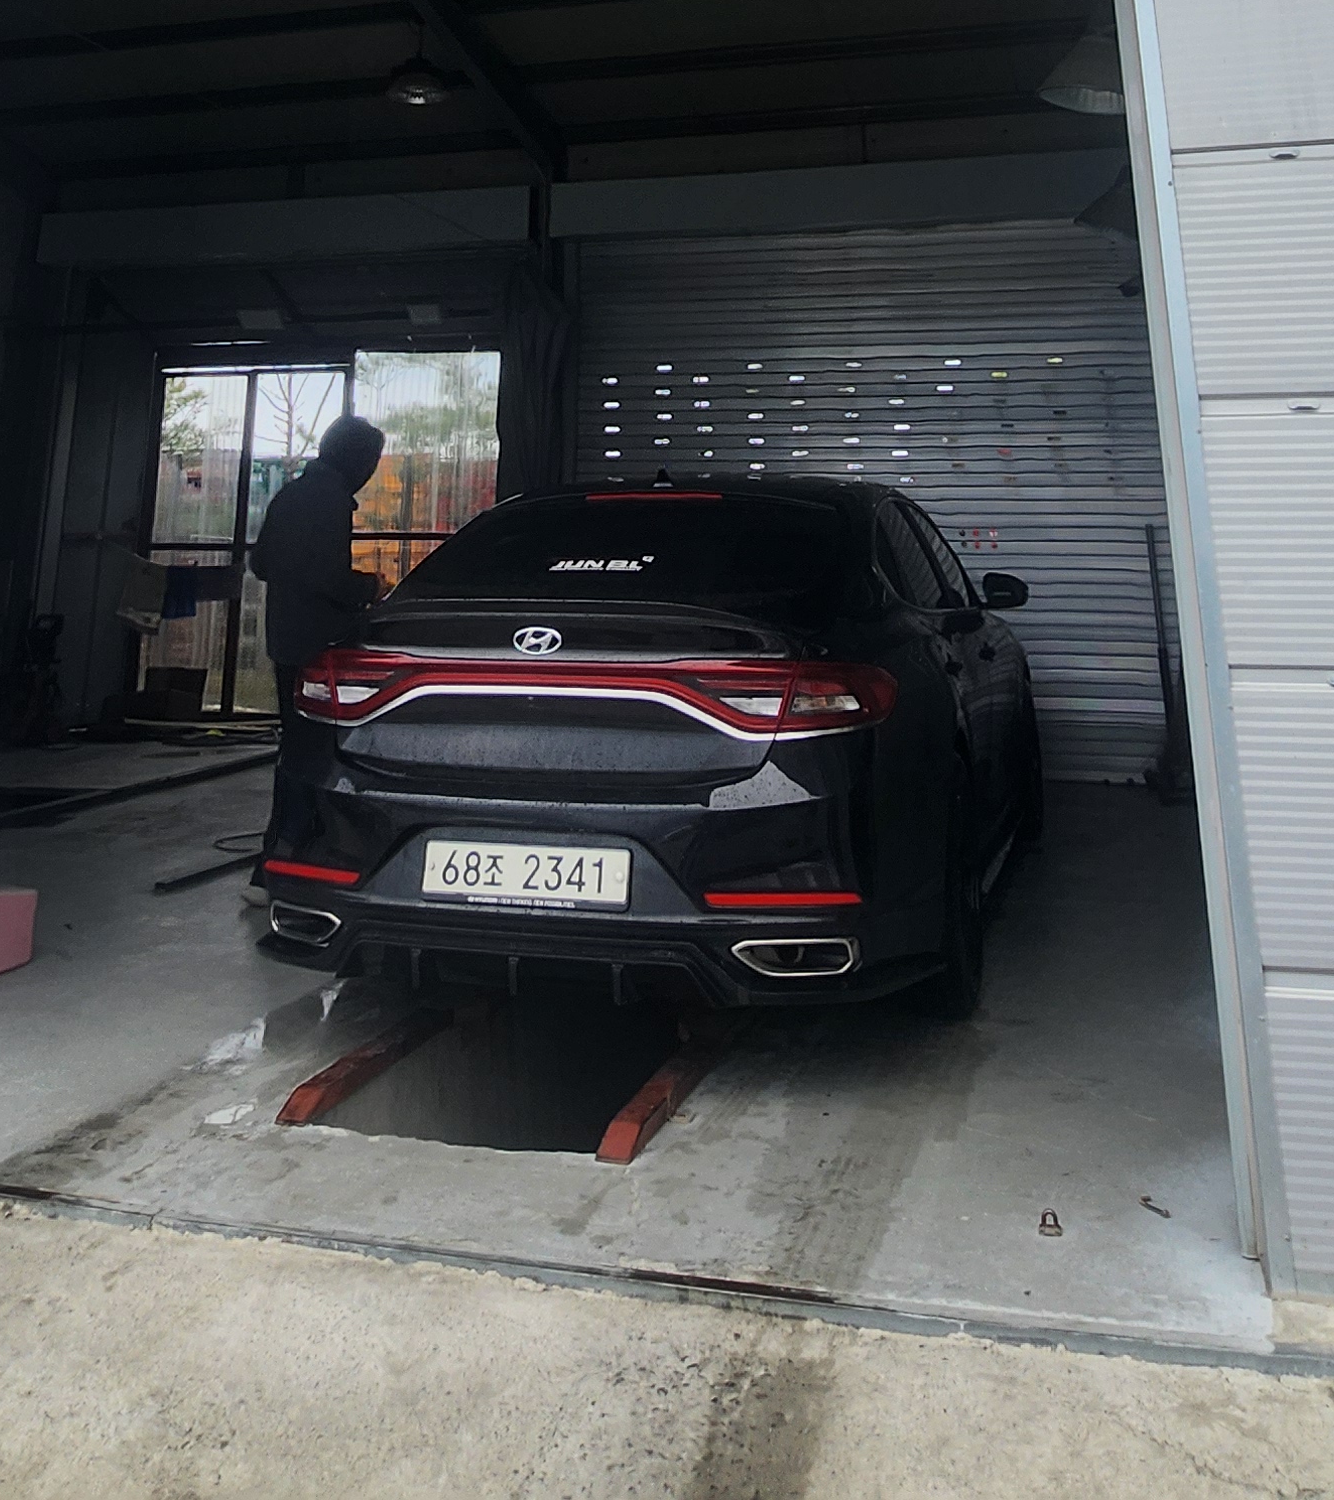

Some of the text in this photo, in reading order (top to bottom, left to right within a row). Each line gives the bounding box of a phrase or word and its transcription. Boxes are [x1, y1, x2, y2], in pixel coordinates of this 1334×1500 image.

[548, 559, 605, 572] JUN
[441, 849, 605, 894] 68조 2341
